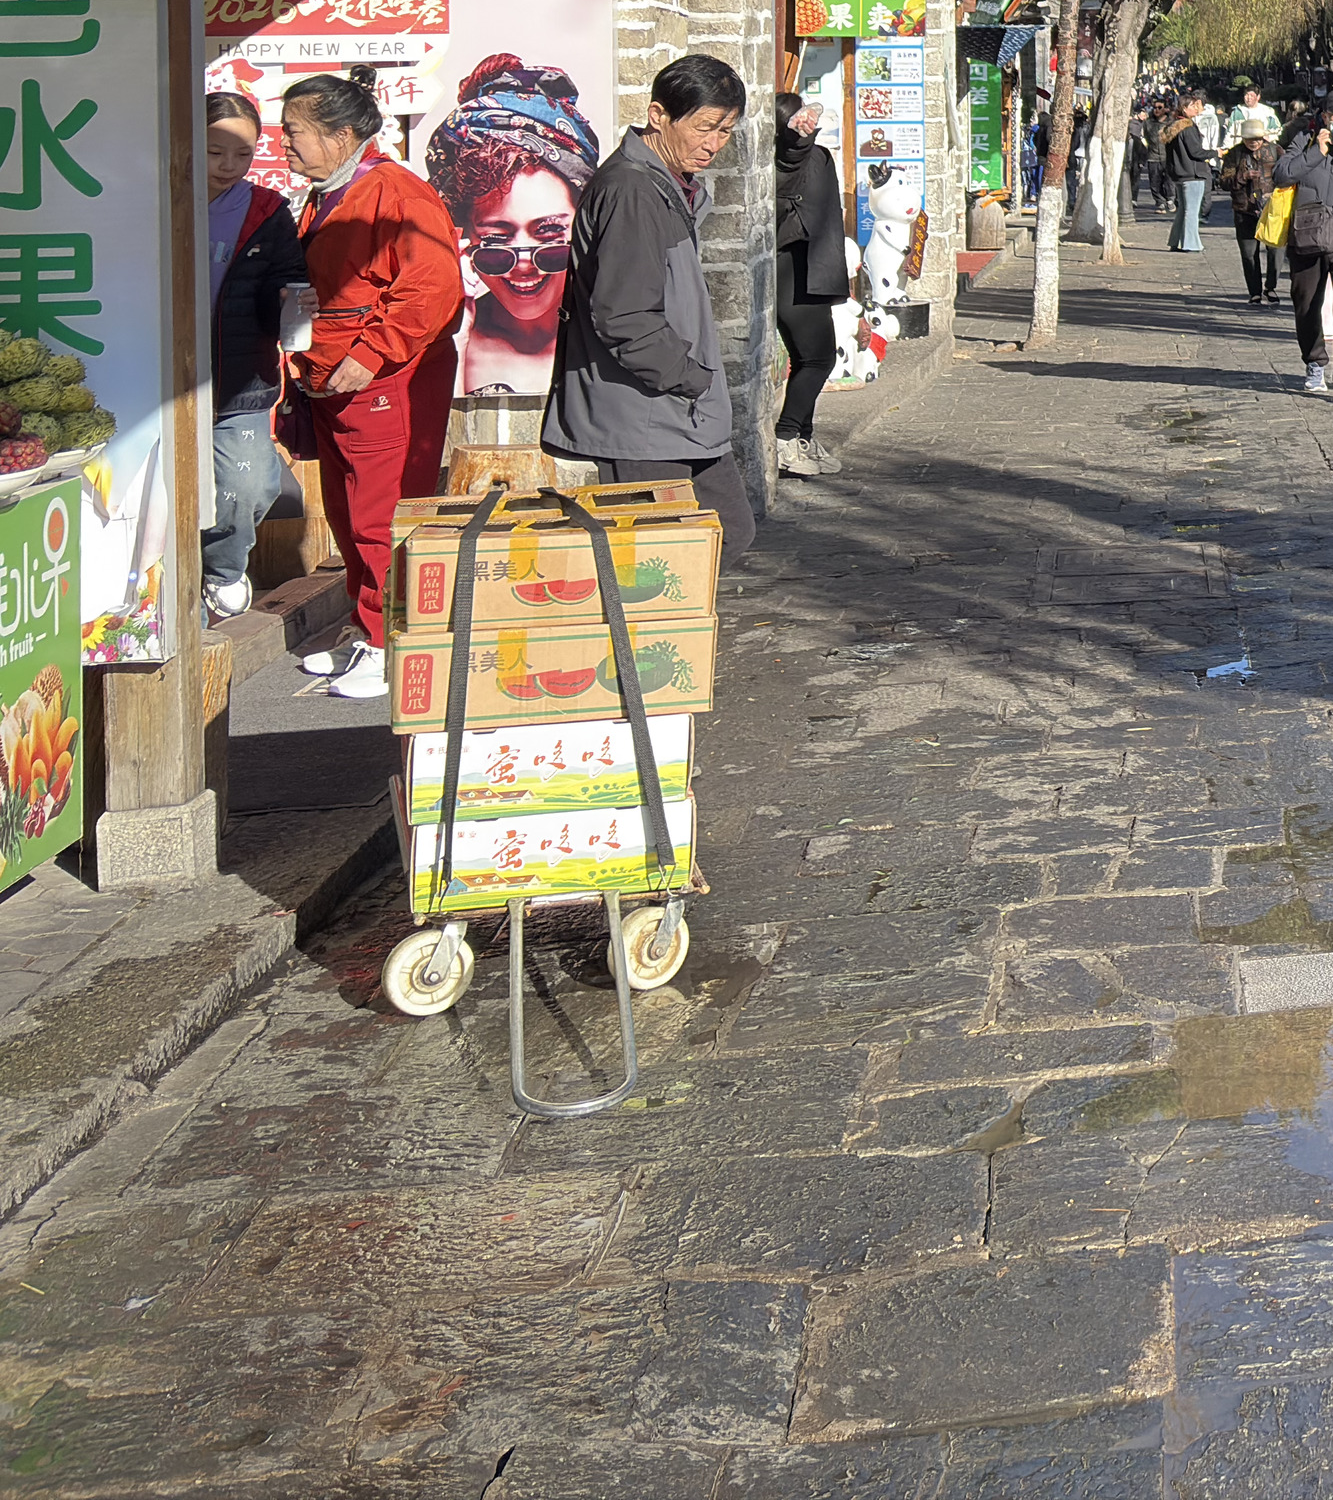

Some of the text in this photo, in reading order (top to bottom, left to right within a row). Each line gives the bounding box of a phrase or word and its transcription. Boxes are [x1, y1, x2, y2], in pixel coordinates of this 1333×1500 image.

[219, 41, 406, 57] HAPPY NEW YEAR
[472, 558, 545, 582] 黑美人
[423, 565, 441, 611] 精品西瓜
[9, 631, 34, 663] fruit
[467, 648, 533, 673] 黑美人
[406, 657, 428, 711] 精品西瓜
